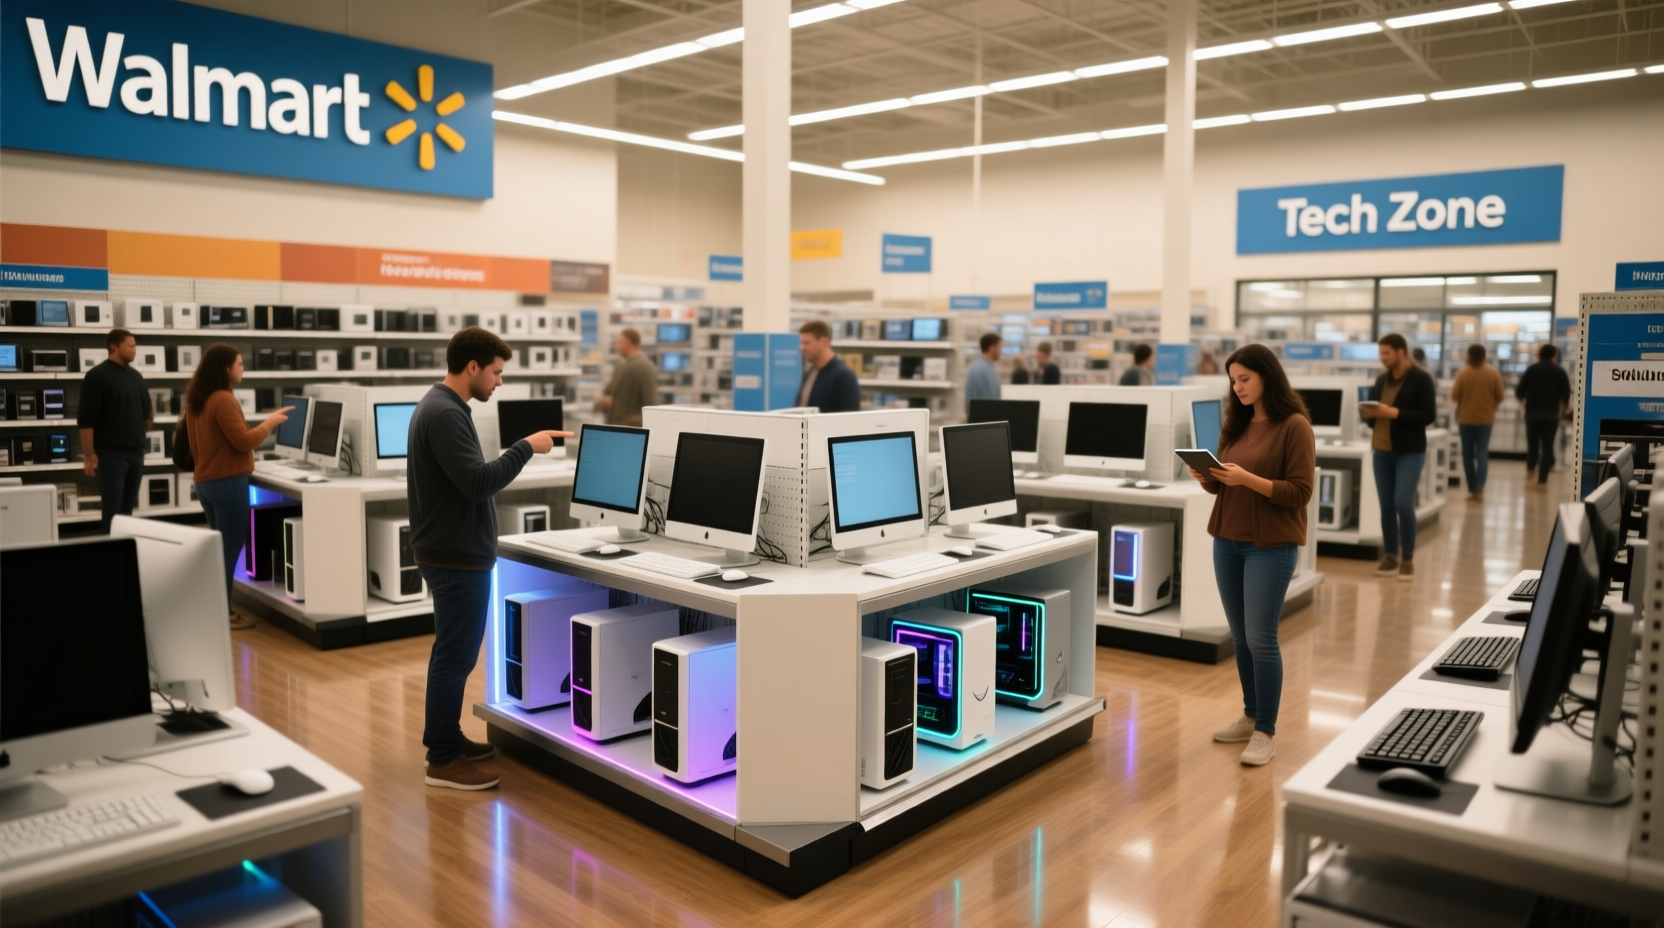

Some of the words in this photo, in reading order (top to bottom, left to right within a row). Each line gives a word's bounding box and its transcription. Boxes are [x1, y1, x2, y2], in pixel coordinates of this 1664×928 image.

[26, 17, 370, 145] Walmart
[1278, 193, 1378, 237] Tech
[1386, 191, 1506, 232] Zone
